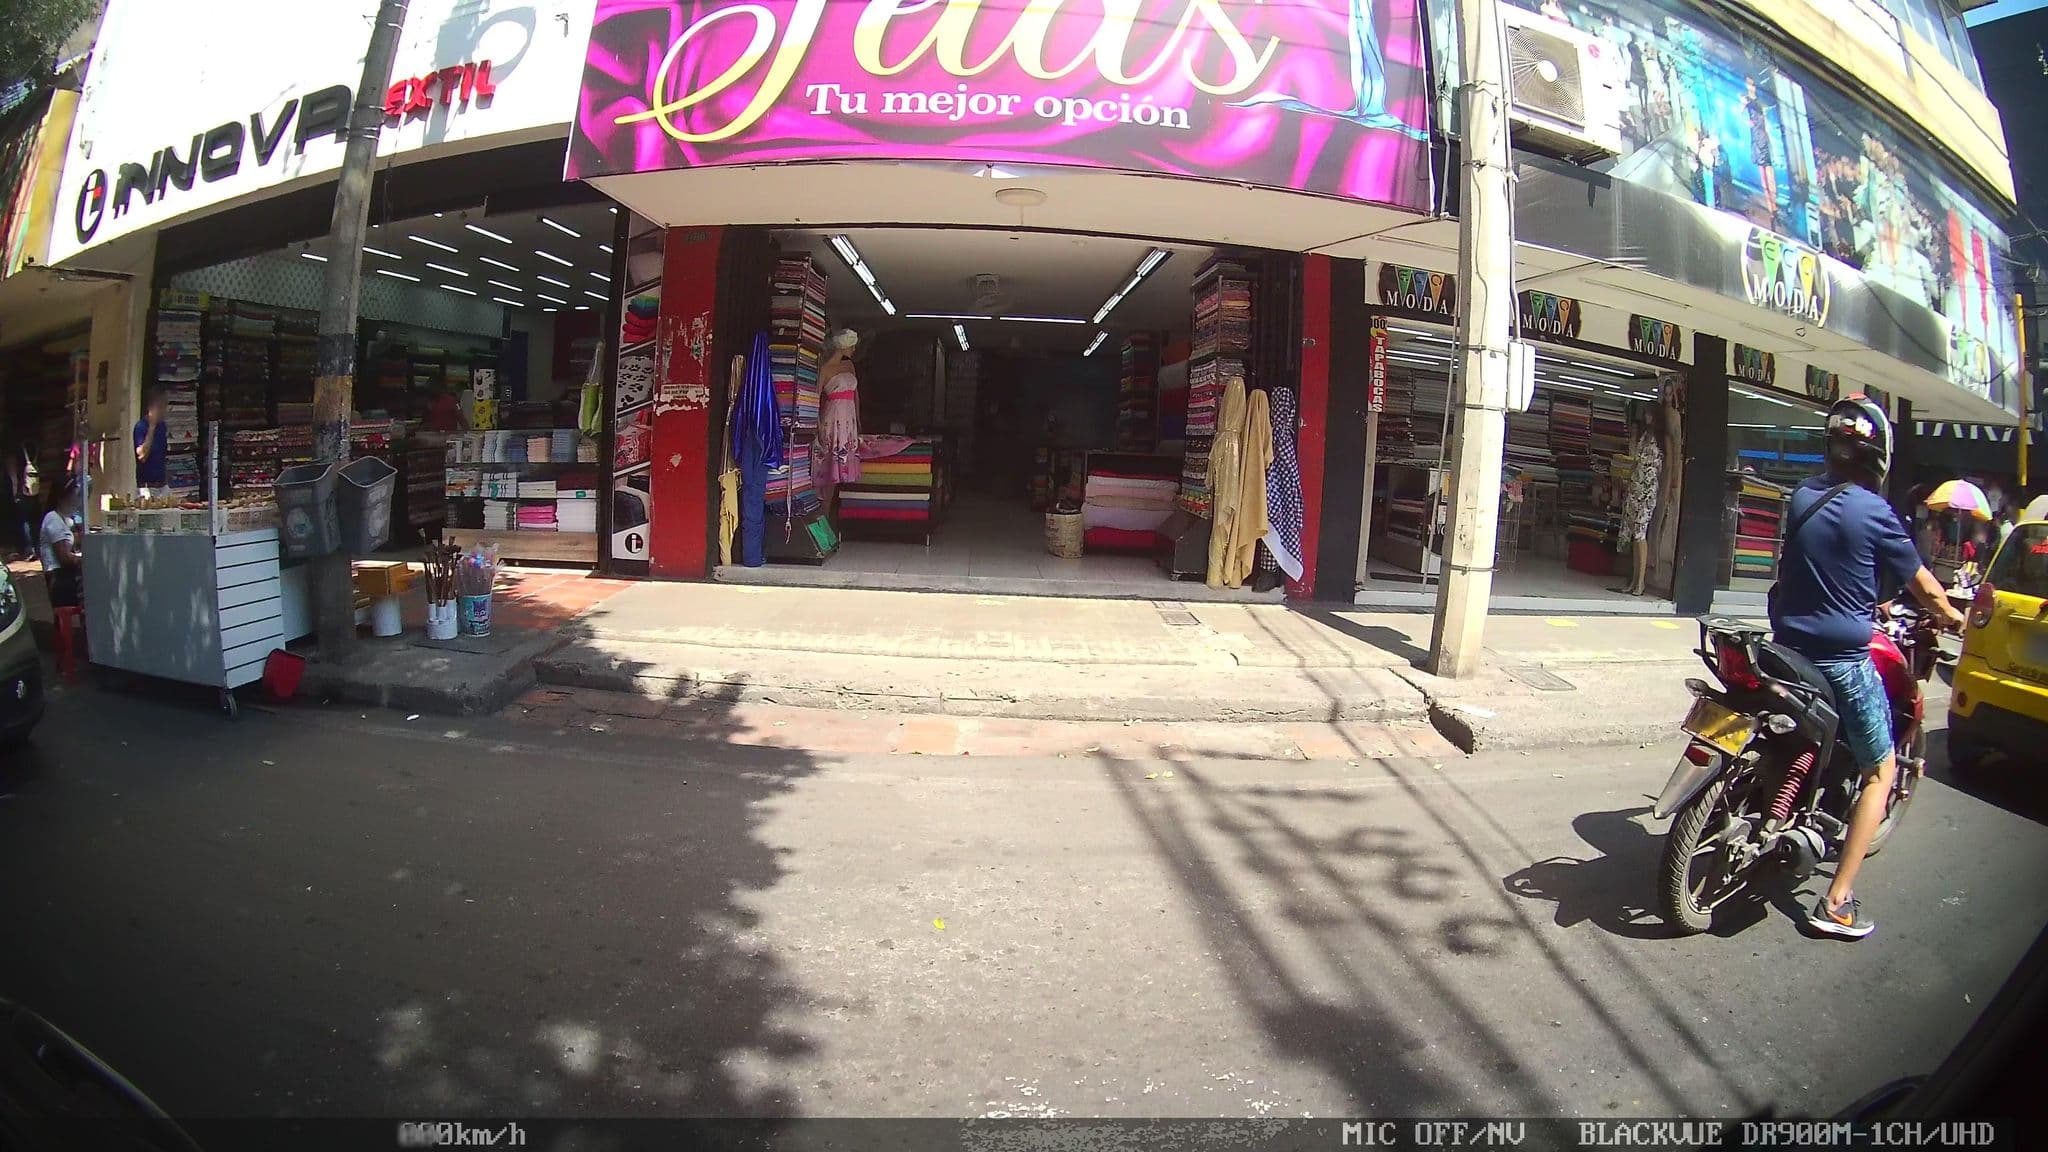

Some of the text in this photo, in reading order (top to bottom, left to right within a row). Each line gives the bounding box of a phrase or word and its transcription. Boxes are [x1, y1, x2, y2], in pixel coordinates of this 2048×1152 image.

[384, 60, 496, 115] EXTIL
[806, 83, 1192, 130] Tu mejor opción
[1386, 289, 1448, 315] MODA
[1753, 274, 1819, 321] MODA
[1523, 313, 1574, 338] MODA
[1633, 337, 1676, 360] MODA
[1372, 336, 1386, 413] TAPABOCAS
[1737, 363, 1772, 385] MODA
